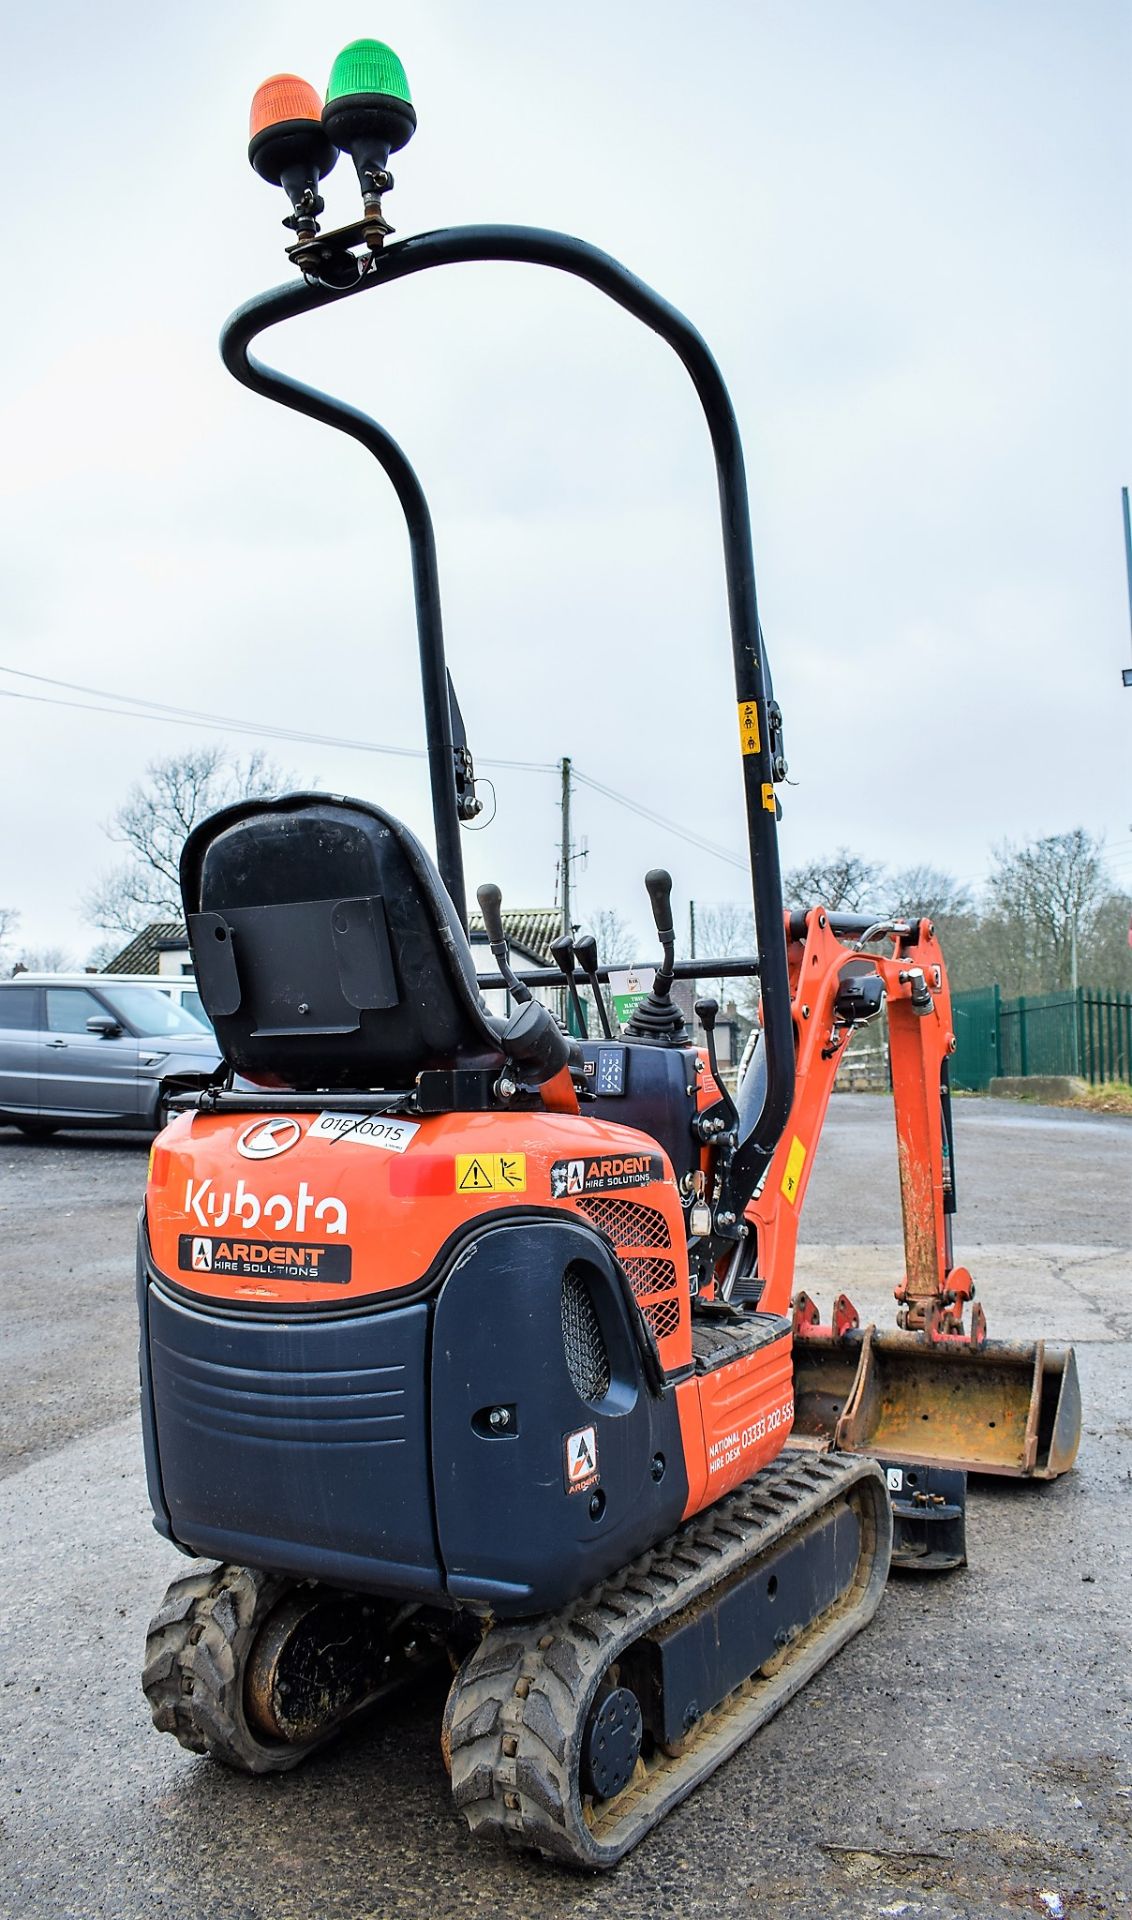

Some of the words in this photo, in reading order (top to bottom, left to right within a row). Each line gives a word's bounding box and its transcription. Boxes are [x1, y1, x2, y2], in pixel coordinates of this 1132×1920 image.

[320, 1117, 405, 1141] 01EX0015
[586, 1156, 652, 1178] ARDENT
[585, 1178, 604, 1189] HIRE
[607, 1173, 650, 1186] SOLUTIONS
[184, 1178, 347, 1235] Kubota
[214, 1261, 238, 1271] HIRE
[215, 1242, 325, 1266] ARDENT
[741, 1418, 766, 1449] 03333
[767, 1408, 781, 1432] 202
[709, 1431, 740, 1458] NATIONAL
[709, 1456, 724, 1474] HIRE
[725, 1446, 741, 1465] DESK
[568, 1474, 598, 1494] ARDENT
